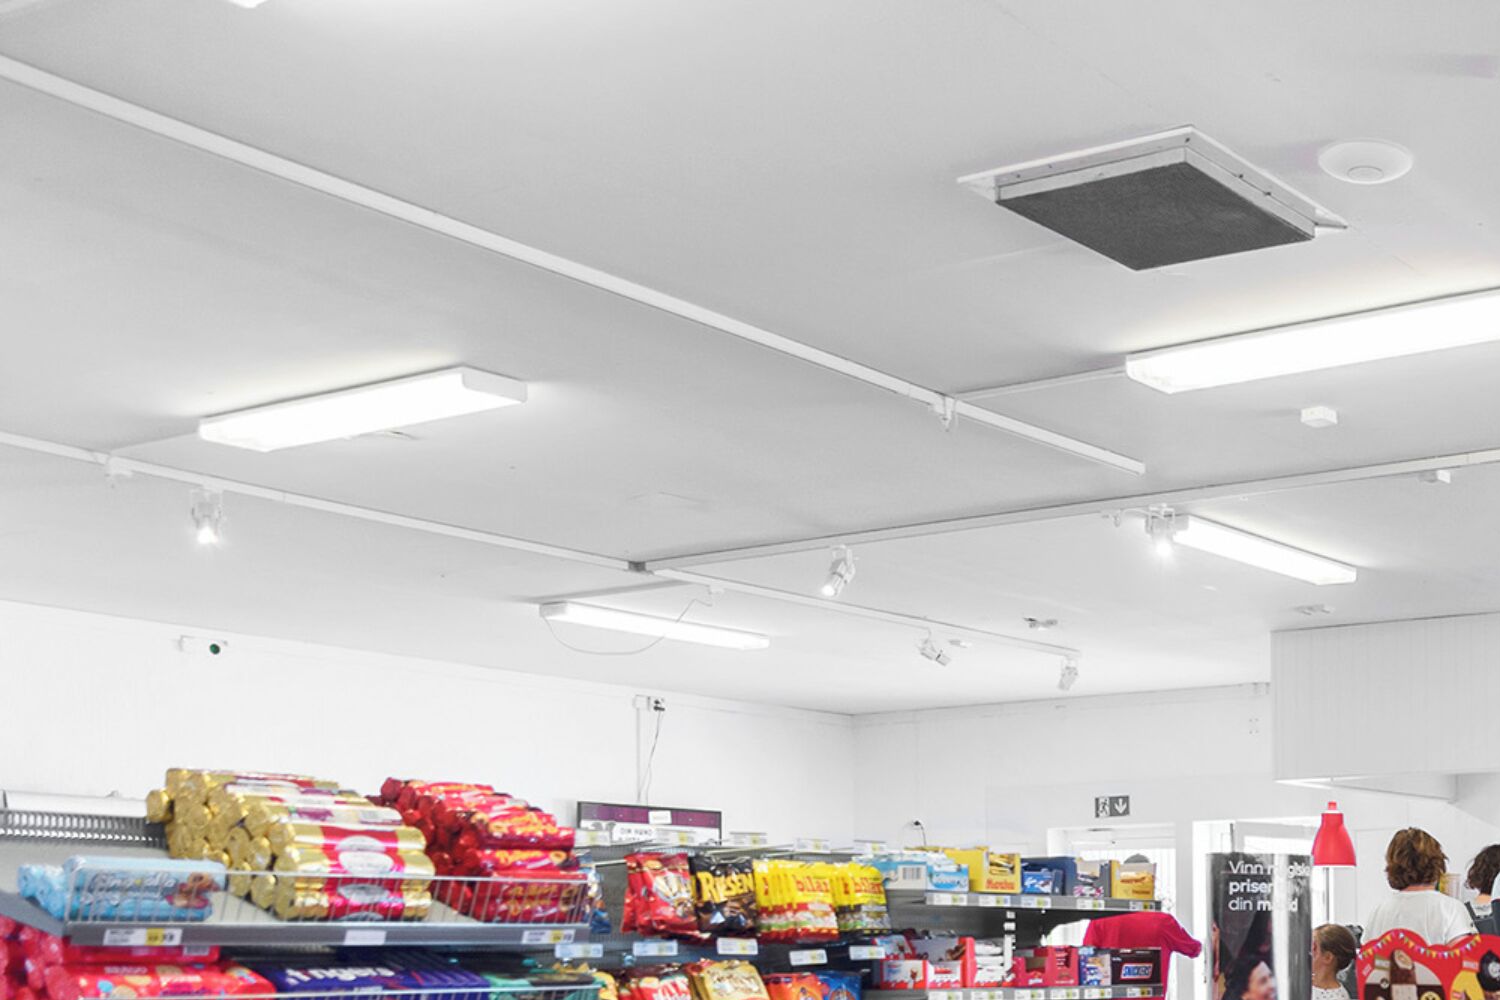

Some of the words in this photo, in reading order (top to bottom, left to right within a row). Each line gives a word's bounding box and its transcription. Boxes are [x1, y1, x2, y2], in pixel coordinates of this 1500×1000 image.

[1228, 860, 1264, 875] Vinn
[697, 871, 755, 904] RIESEN
[1229, 878, 1273, 895] priser
[1228, 897, 1253, 911] din
